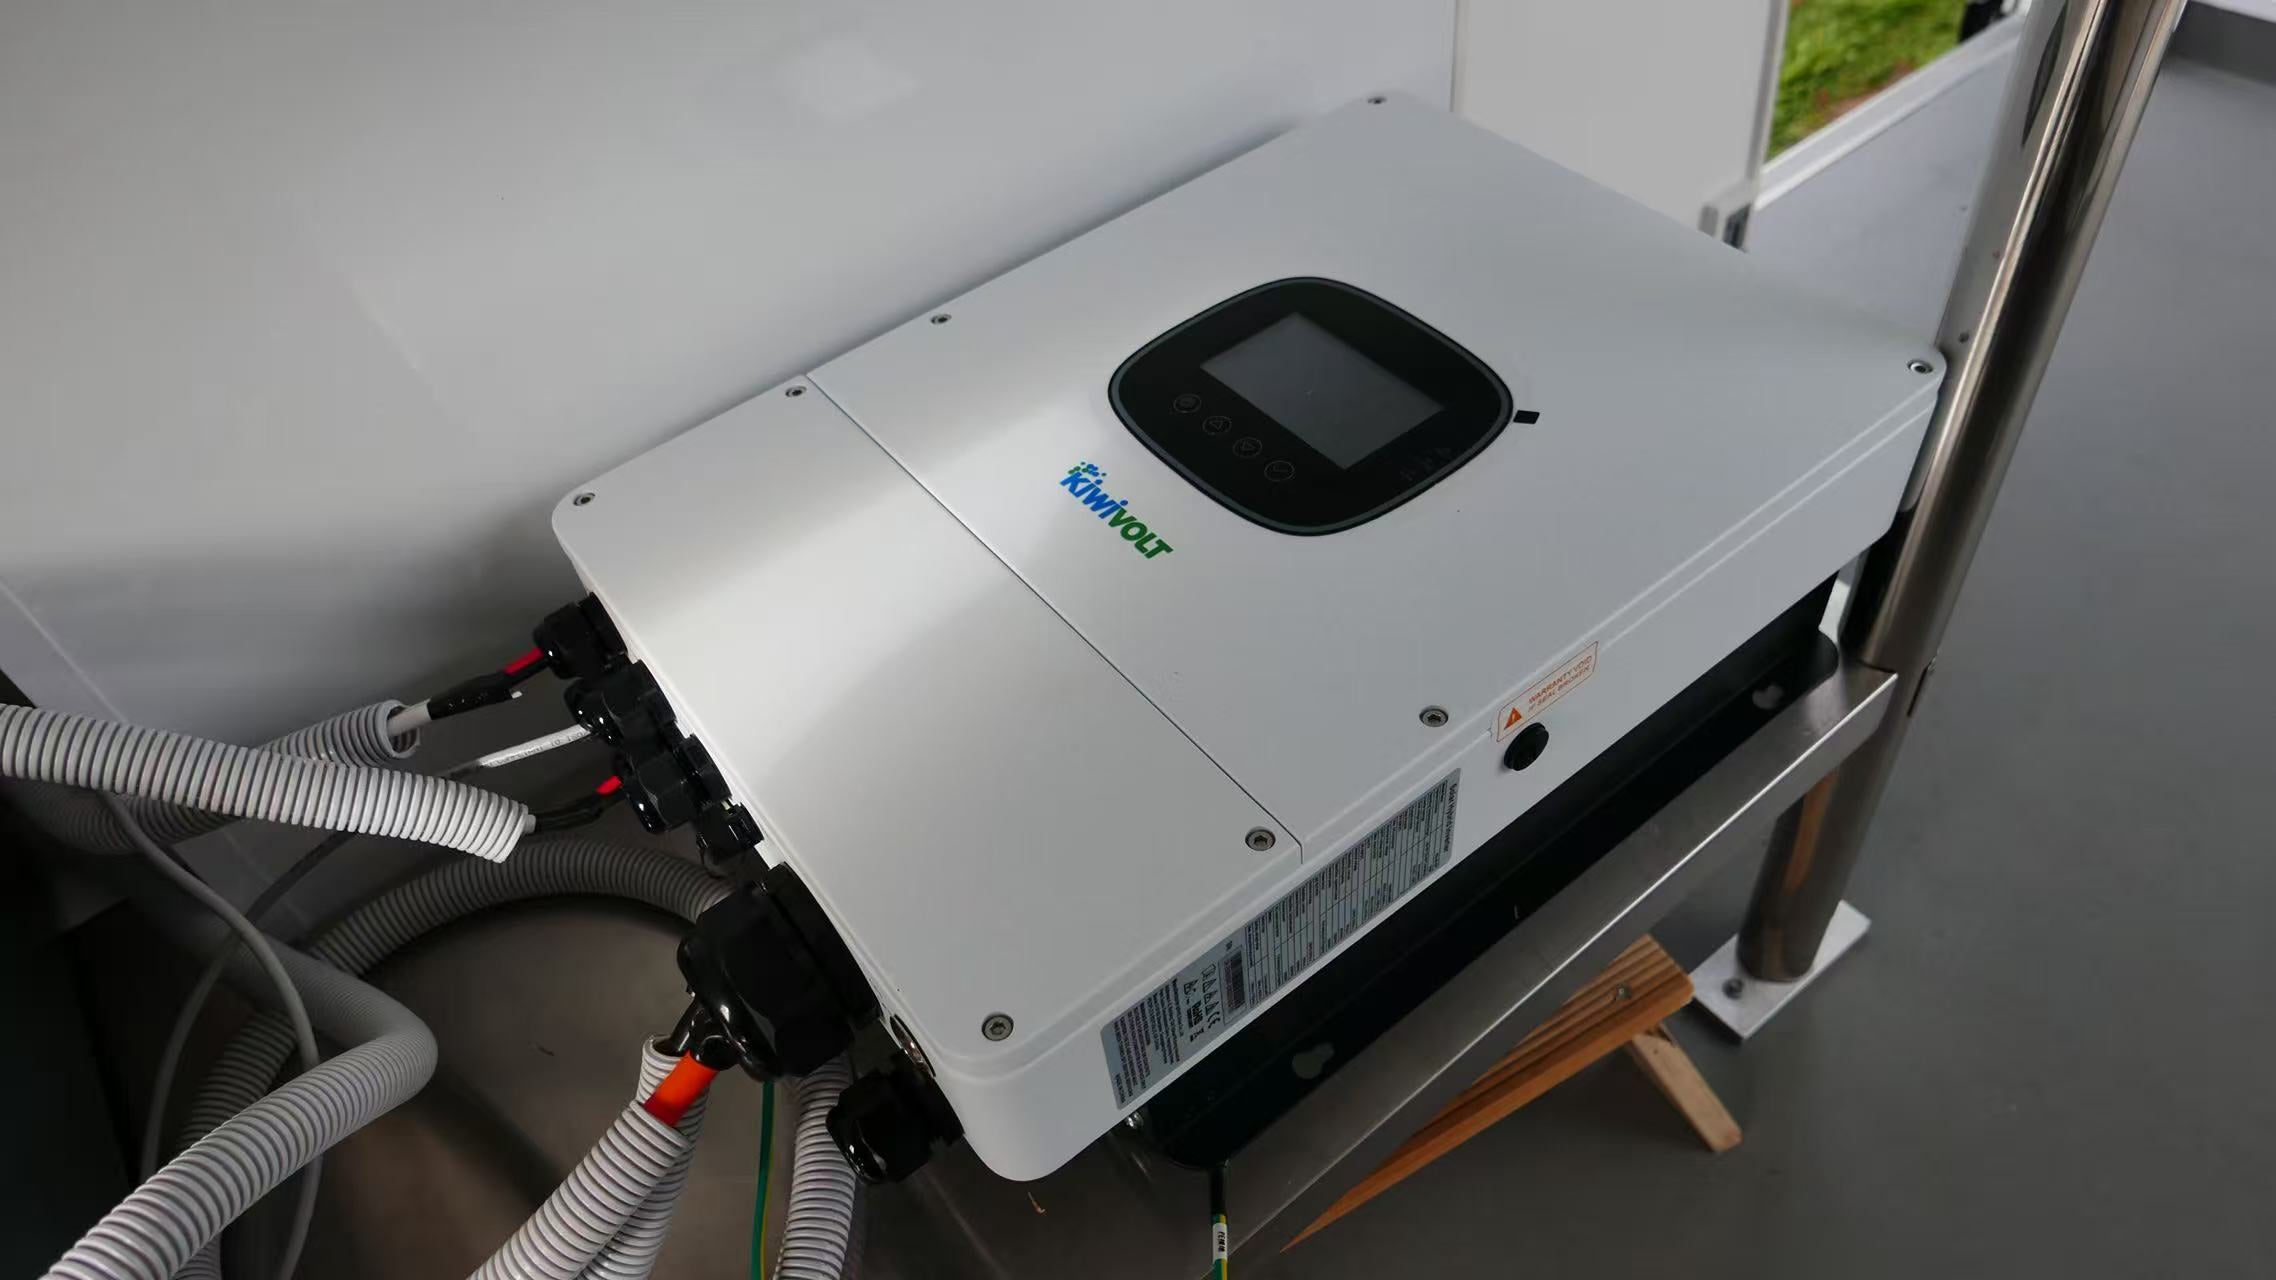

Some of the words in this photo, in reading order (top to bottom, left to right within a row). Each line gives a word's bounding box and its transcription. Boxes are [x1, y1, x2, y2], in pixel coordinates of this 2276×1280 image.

[1529, 671, 1571, 703] WARRANTY
[1572, 655, 1592, 674] VOID
[1537, 690, 1556, 706] SEAL
[1558, 664, 1590, 691] BROKEN
